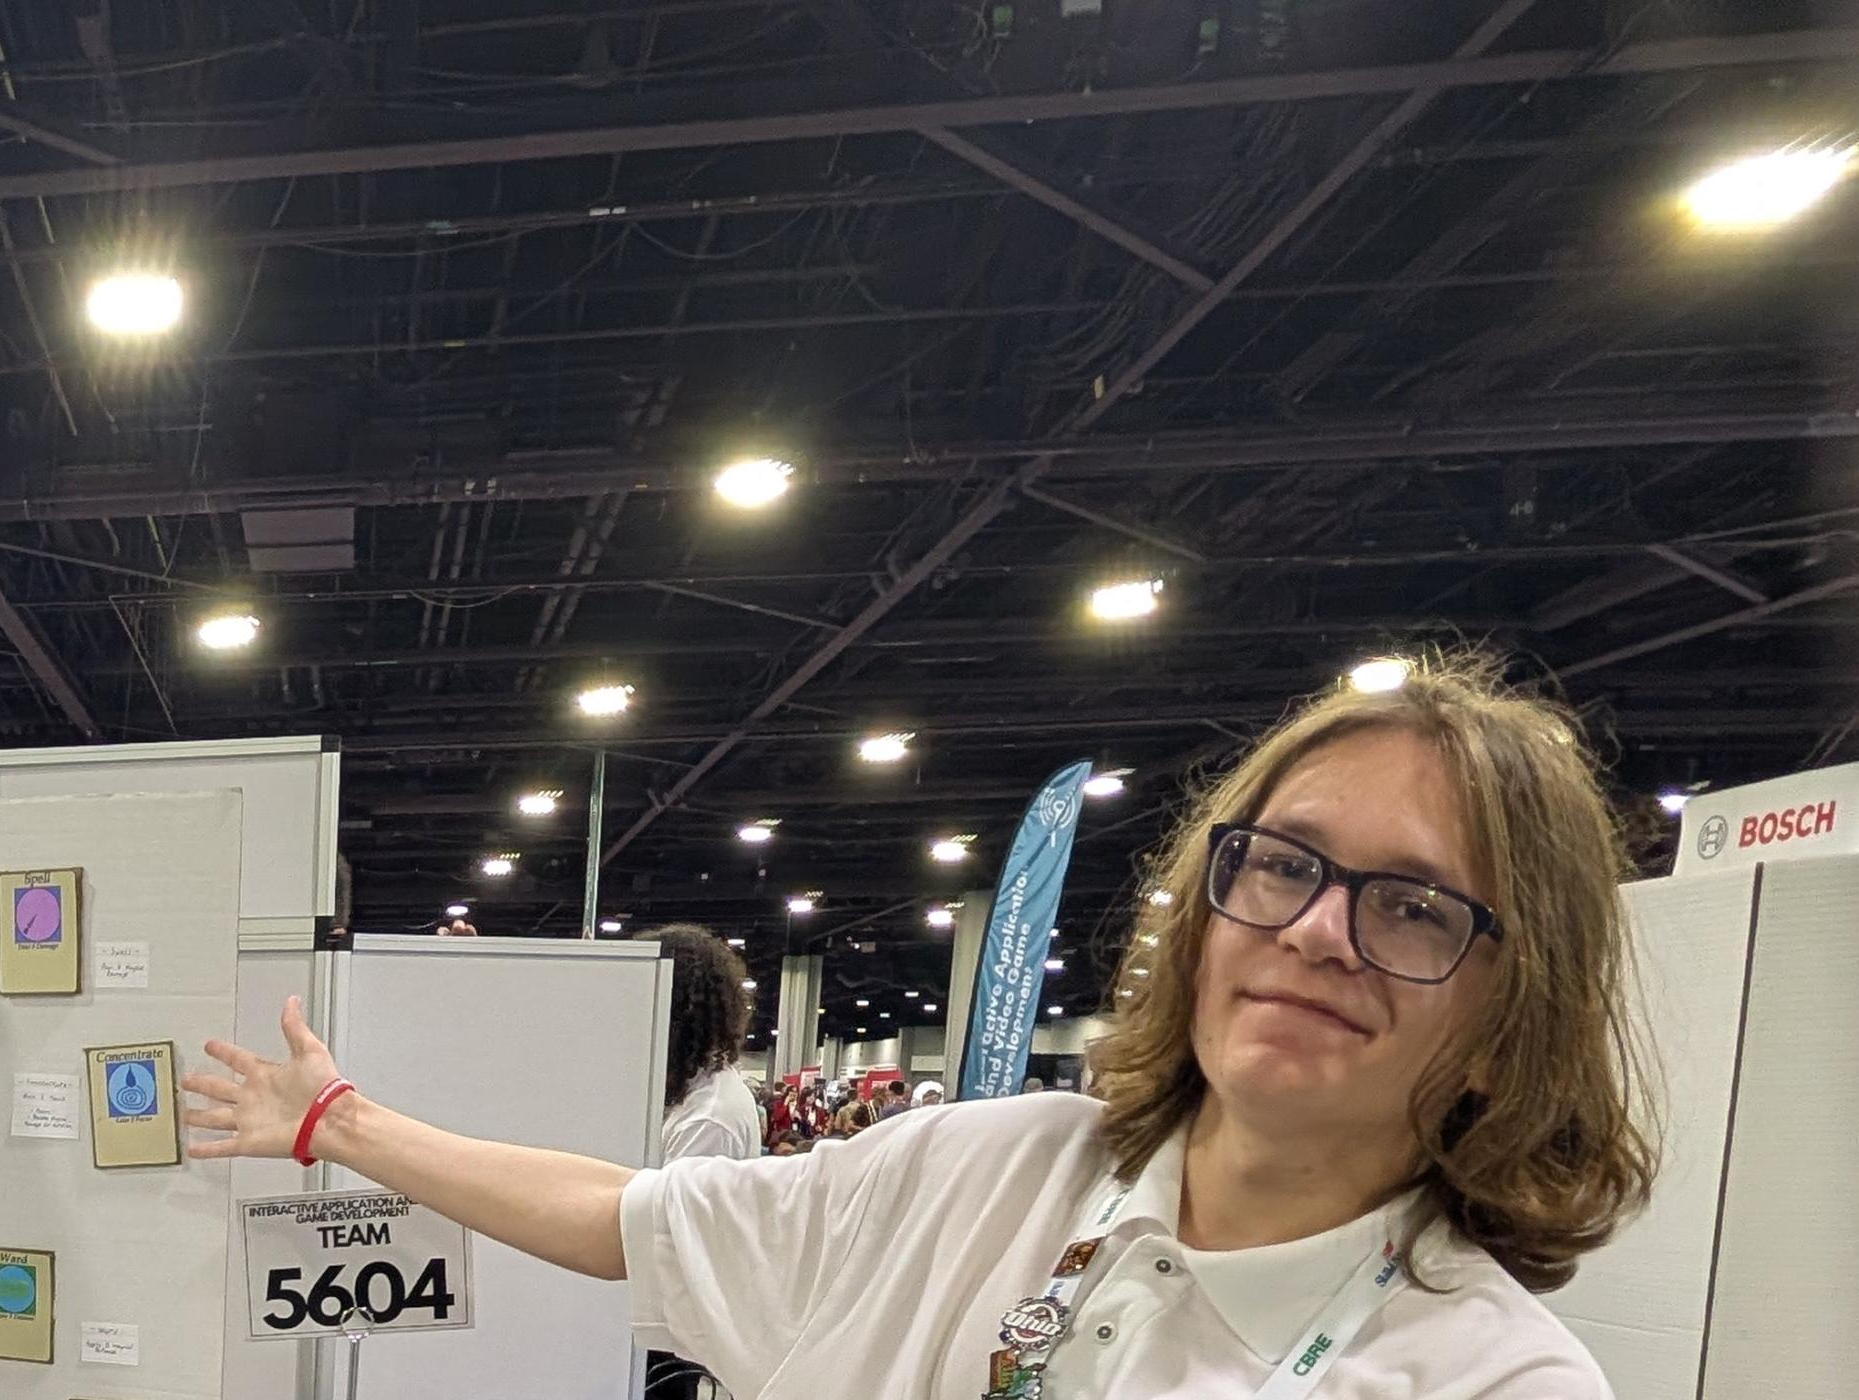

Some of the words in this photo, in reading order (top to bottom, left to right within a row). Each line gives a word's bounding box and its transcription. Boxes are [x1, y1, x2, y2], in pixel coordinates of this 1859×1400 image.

[1739, 800, 1836, 848] BOSCH
[24, 871, 51, 888] Spell
[1007, 923, 1031, 984] Game
[993, 991, 1015, 1051] Video
[96, 1049, 164, 1063] Concentrate
[986, 1056, 1002, 1097] and
[249, 1202, 318, 1217] INTERACTIVE
[320, 1197, 394, 1212] APPLICATION
[396, 1196, 413, 1206] AN
[296, 1213, 328, 1224] GAME
[331, 1207, 409, 1221] DEVELOPMENT
[317, 1223, 391, 1248] TEAM
[0, 1252, 28, 1264] Ward
[263, 1258, 454, 1330] 5604
[1003, 1310, 1062, 1337] Ohio
[1293, 1332, 1333, 1377] CBRE
